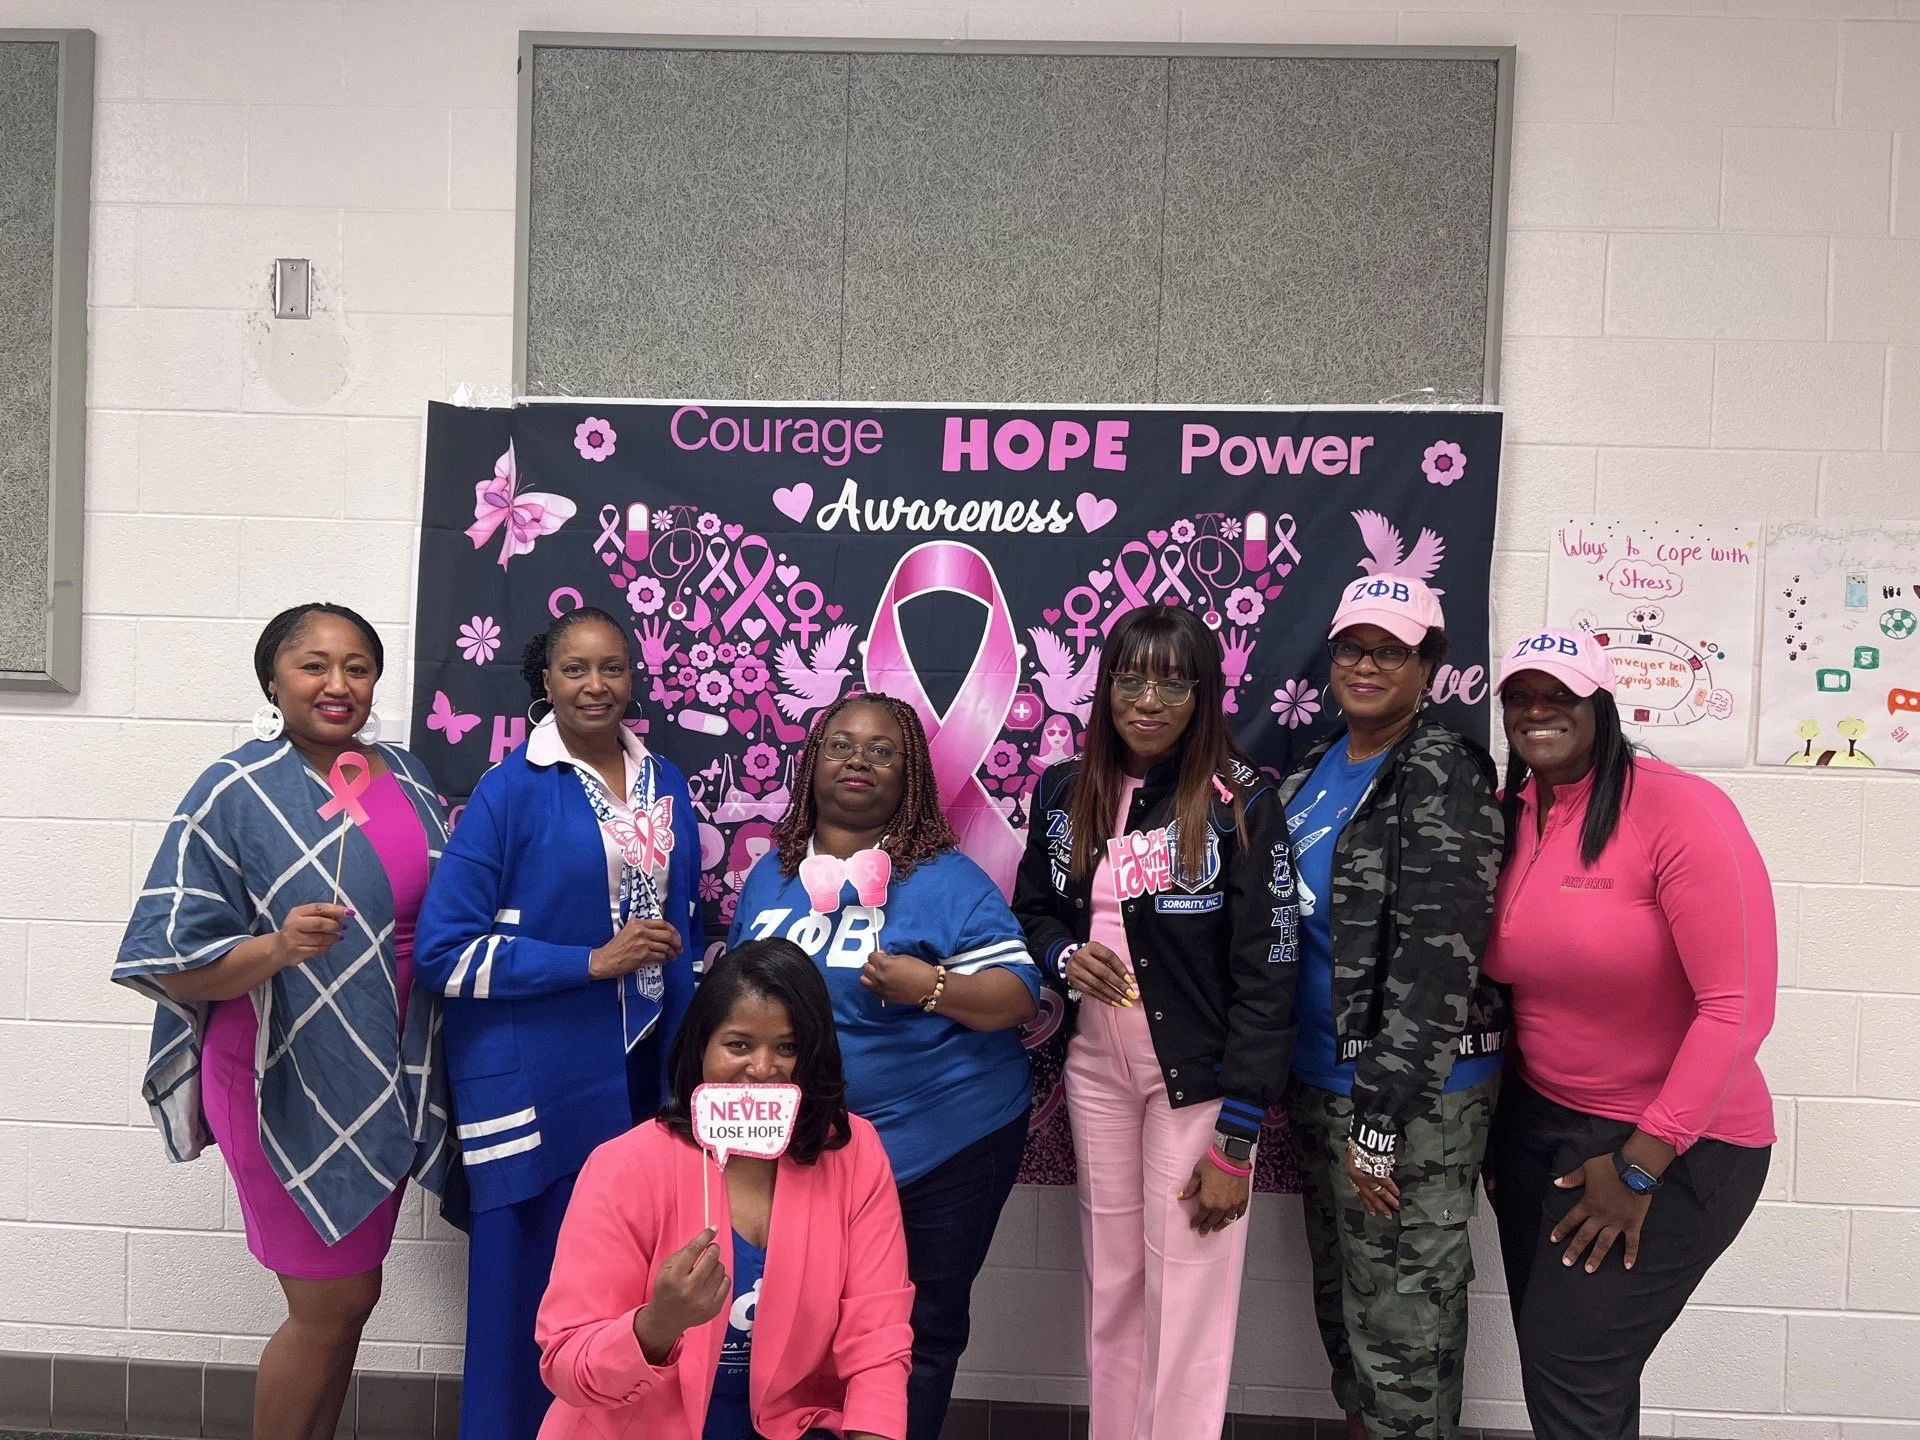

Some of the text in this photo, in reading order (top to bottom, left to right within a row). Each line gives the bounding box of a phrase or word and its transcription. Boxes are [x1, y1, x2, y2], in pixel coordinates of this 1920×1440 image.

[670, 405, 1375, 476] Courage HOPE Power
[816, 477, 1074, 534] Awareness
[1562, 529, 1608, 565] Ways
[1626, 535, 1640, 557] to
[1710, 547, 1750, 565] with
[1619, 568, 1673, 590] Stress
[1610, 656, 1688, 677] nveyer belt
[1428, 663, 1489, 706] ve
[1107, 828, 1166, 869] HOPE
[1141, 846, 1169, 870] FAITH
[1114, 867, 1172, 900] LOVE
[1560, 875, 1614, 889] FORT DRUM
[1162, 899, 1205, 910] SORORITY,
[1271, 904, 1299, 927] ZET
[1280, 924, 1298, 945] PH
[1268, 943, 1299, 963] BET
[1342, 1040, 1372, 1060] LOV
[1459, 1034, 1474, 1055] VE
[710, 1100, 782, 1121] NEVER
[709, 1125, 784, 1139] LOSE HOPE
[1358, 1124, 1397, 1152] LOVE
